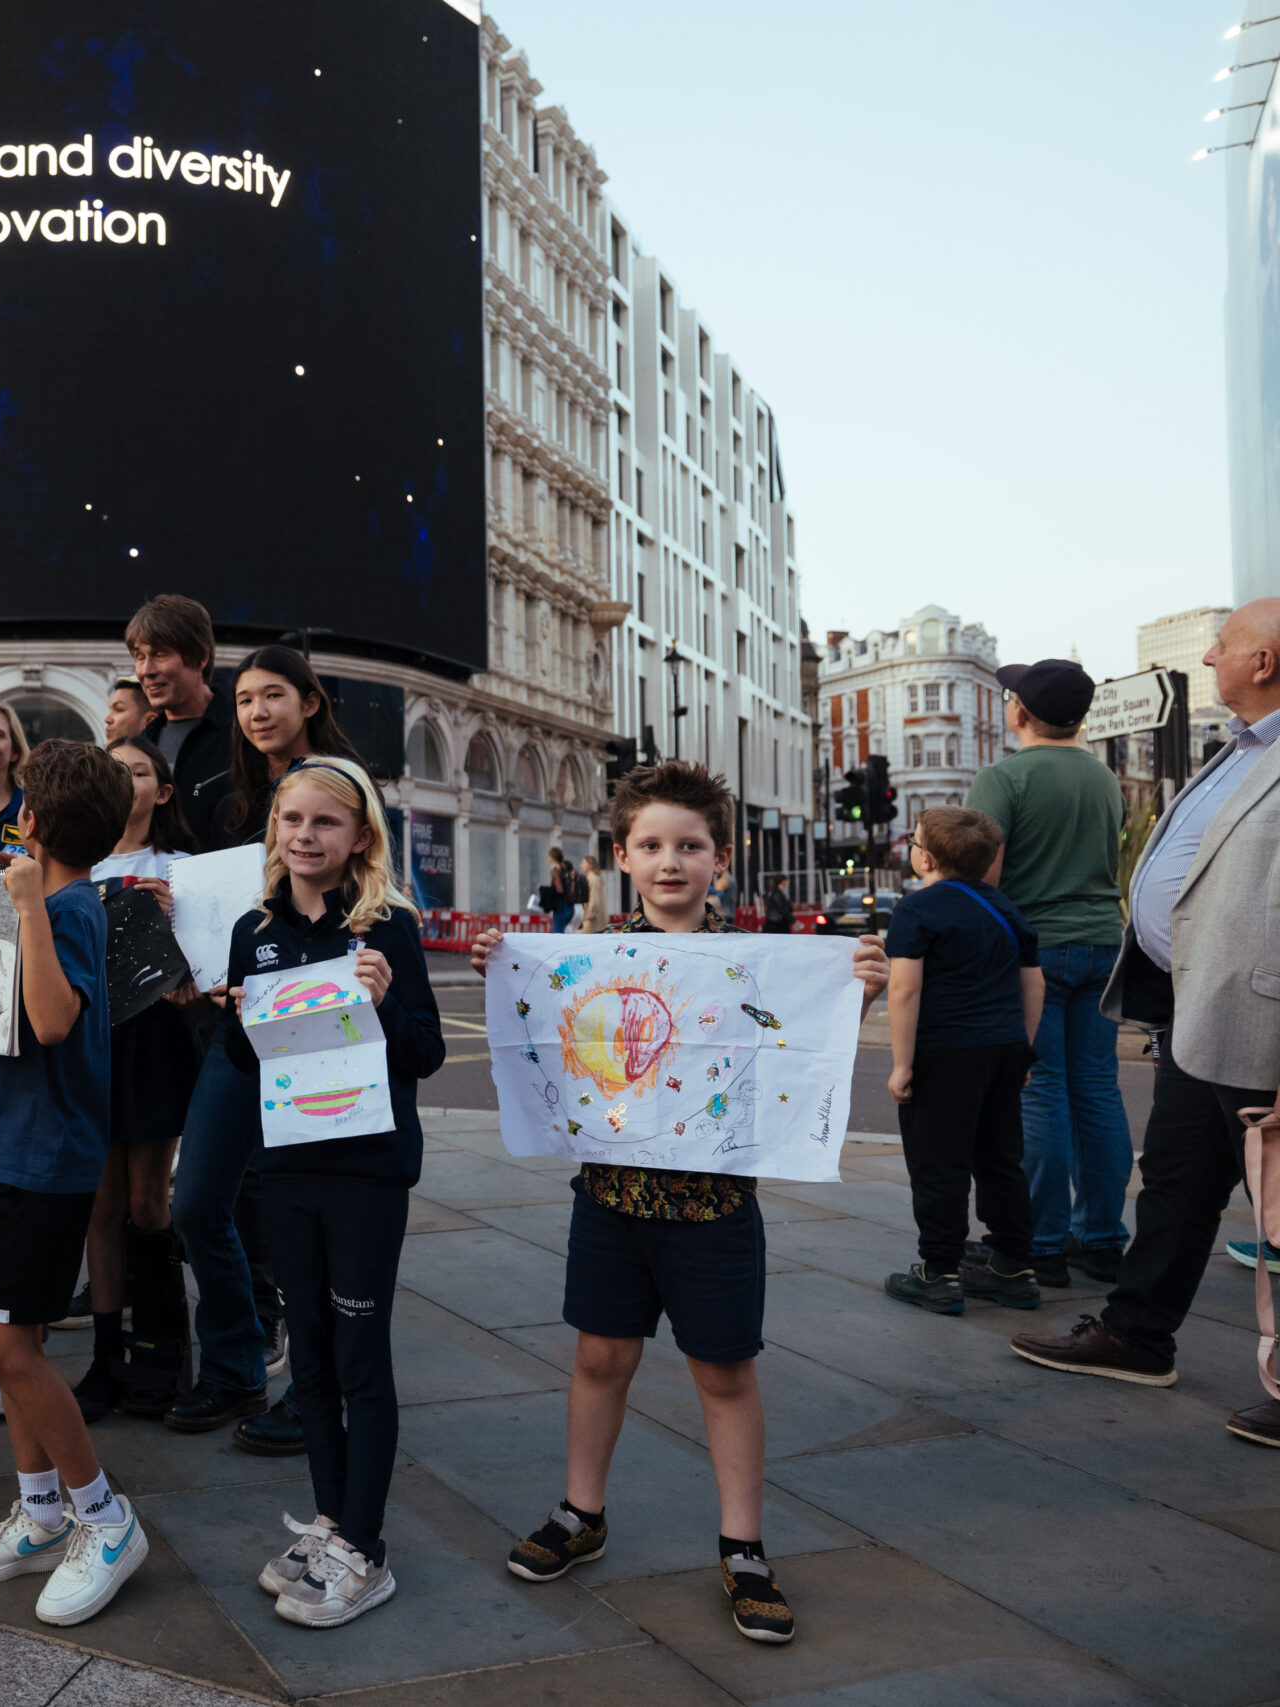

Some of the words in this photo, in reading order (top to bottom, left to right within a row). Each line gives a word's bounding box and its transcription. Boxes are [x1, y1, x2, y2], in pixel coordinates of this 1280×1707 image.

[107, 135, 292, 208] diversity
[1103, 688, 1118, 701] City
[1123, 697, 1151, 713] Square
[1109, 719, 1125, 730] Park
[1128, 713, 1154, 727] Corner
